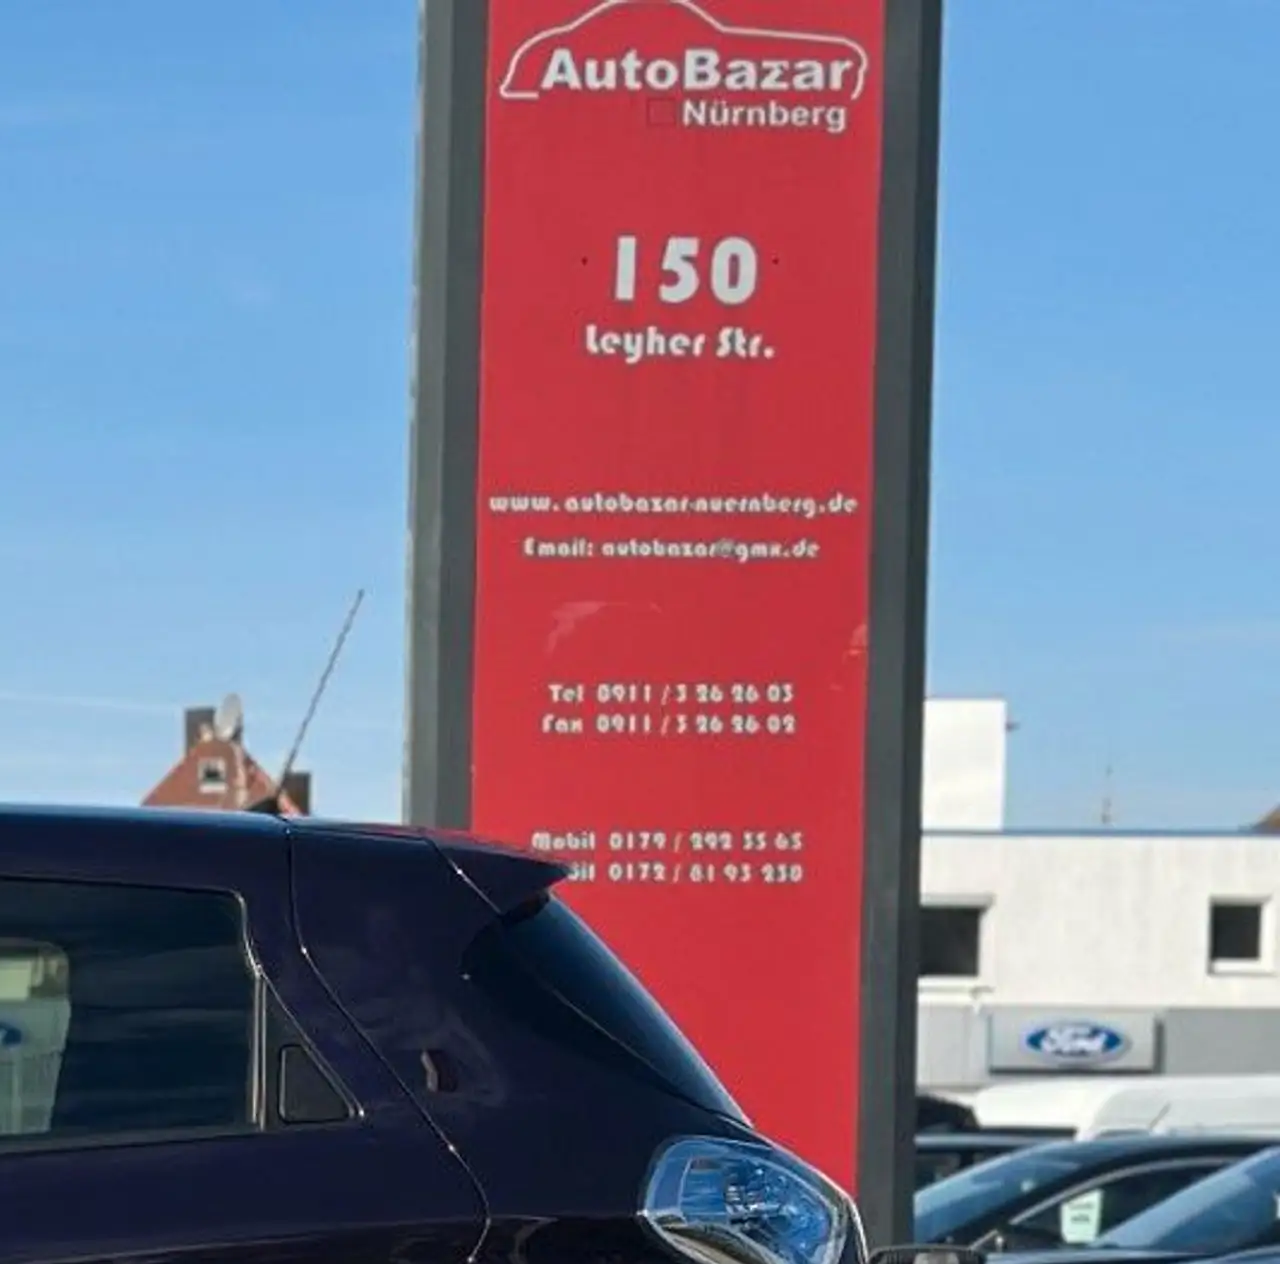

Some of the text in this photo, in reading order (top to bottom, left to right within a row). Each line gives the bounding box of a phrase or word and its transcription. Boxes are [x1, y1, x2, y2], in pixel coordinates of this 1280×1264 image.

[540, 48, 854, 92] AutoBazar
[682, 99, 847, 133] Nürnberg
[614, 235, 758, 305] 150
[585, 323, 775, 364] Leyher Str.
[523, 536, 594, 558] Email:
[547, 683, 585, 703] Tel
[596, 683, 652, 704] 0911
[541, 713, 584, 734] Fax
[595, 713, 652, 734] 0911
[530, 830, 596, 852] Mobil
